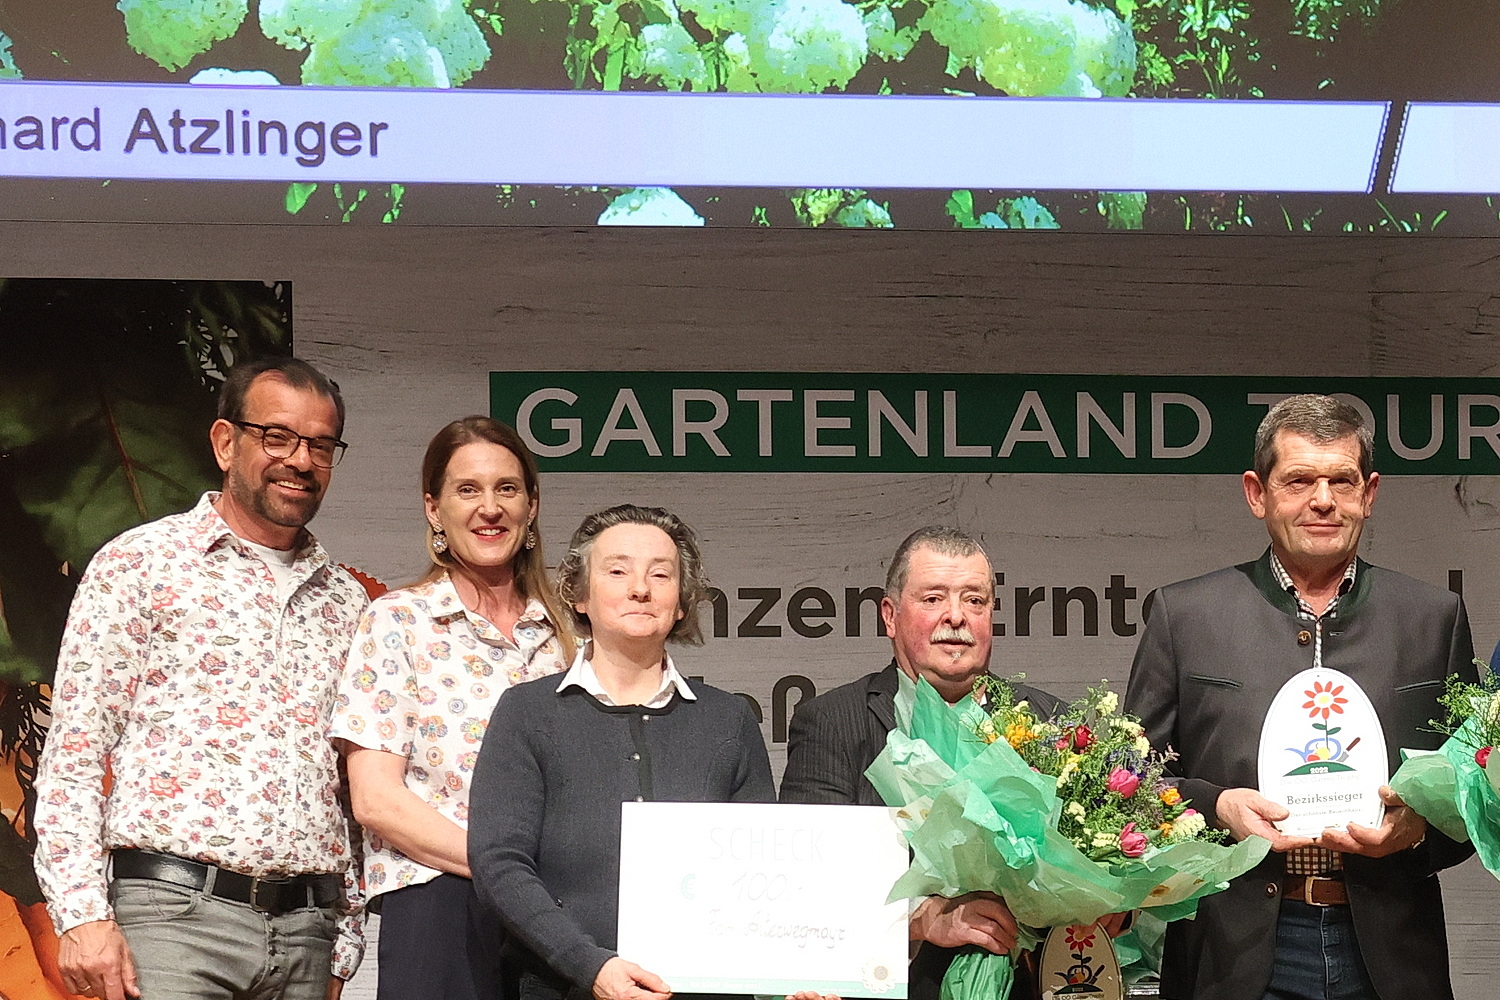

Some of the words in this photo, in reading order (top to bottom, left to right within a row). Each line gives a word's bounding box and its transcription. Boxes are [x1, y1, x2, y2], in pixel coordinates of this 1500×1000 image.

[124, 107, 389, 167] Atzlinger
[514, 387, 1214, 460] GARTENLAND
[705, 586, 890, 638] nzen
[992, 572, 1159, 637] rnt
[1286, 791, 1364, 806] Bezirkssieger
[709, 826, 824, 862] SCHECK
